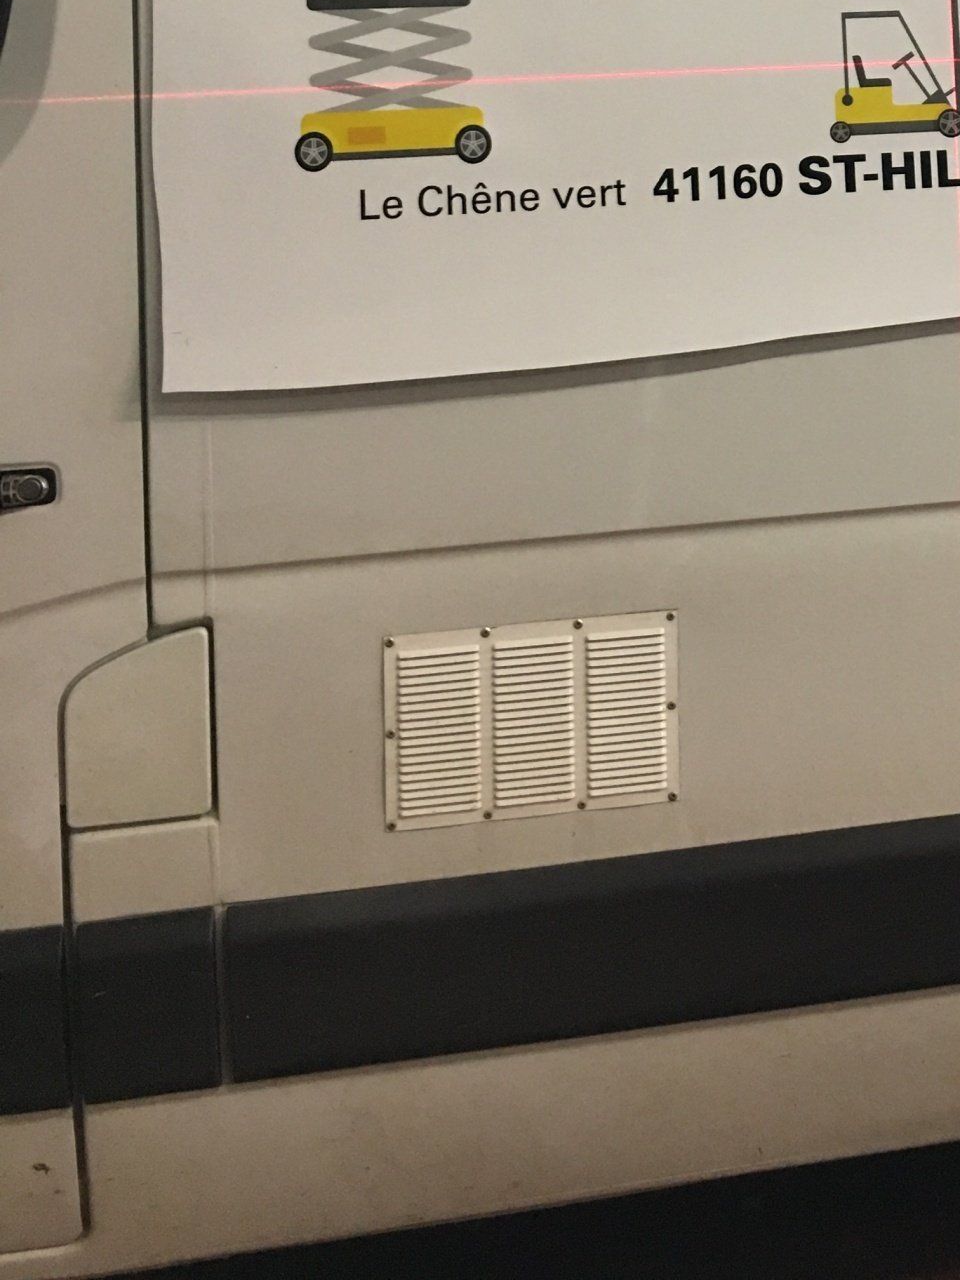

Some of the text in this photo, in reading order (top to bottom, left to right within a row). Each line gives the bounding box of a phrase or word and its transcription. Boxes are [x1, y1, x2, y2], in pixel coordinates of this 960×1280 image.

[359, 188, 404, 221] Le
[416, 177, 540, 217] Chêne
[552, 178, 627, 210] vert
[652, 161, 784, 204] 41160
